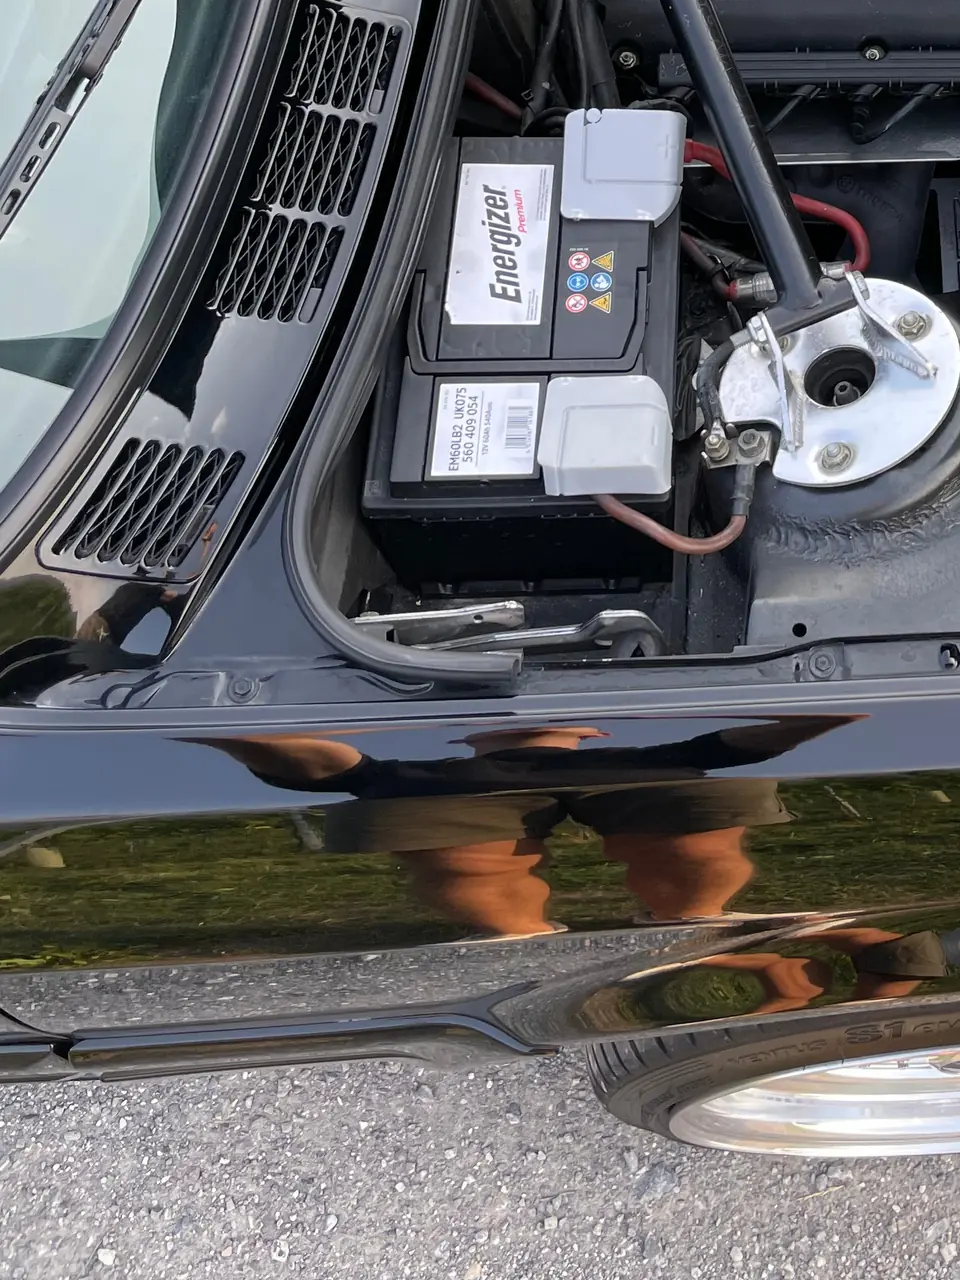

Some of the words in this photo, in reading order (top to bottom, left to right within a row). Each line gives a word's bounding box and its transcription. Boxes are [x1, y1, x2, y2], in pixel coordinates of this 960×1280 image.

[514, 189, 527, 233] Premium
[481, 184, 522, 303] Energizer
[453, 387, 467, 419] UK075
[467, 395, 478, 416] 054
[465, 418, 476, 439] 409
[448, 424, 463, 471] EM60LB2
[462, 442, 474, 463] 560
[844, 1021, 906, 1045] S1
